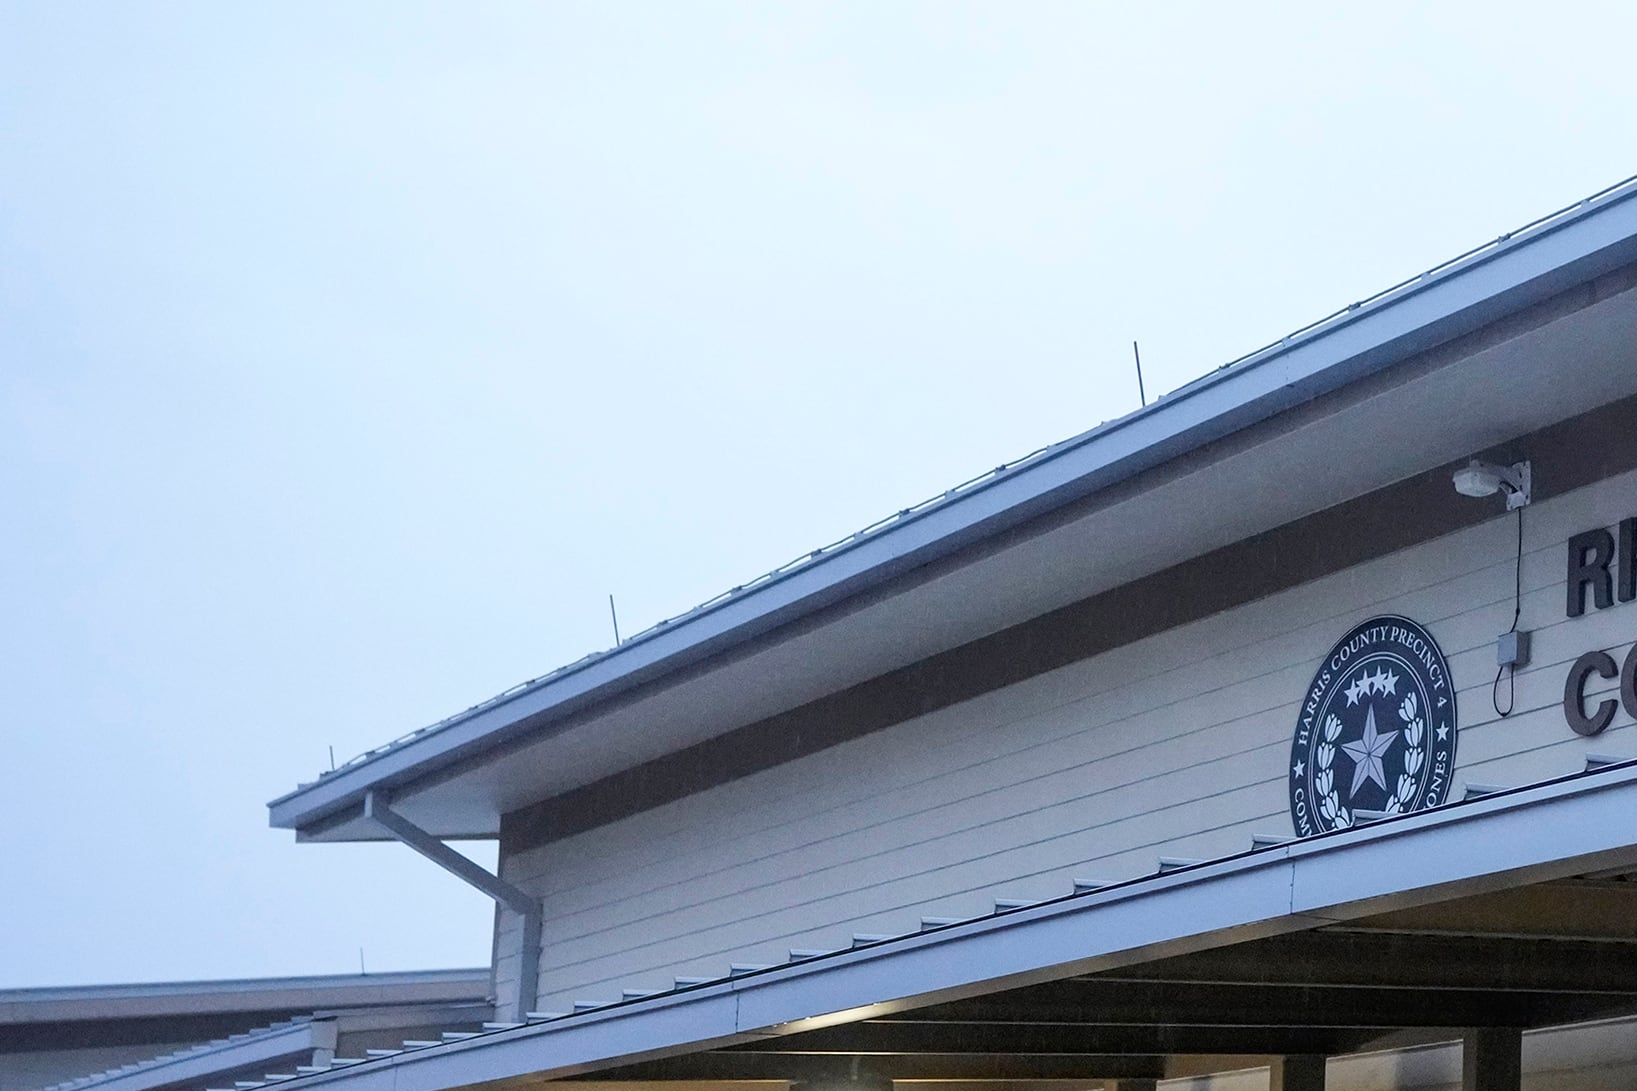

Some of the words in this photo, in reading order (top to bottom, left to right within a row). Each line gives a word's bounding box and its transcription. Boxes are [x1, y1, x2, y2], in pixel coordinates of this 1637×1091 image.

[1299, 670, 1331, 746] HARRIS
[1331, 625, 1389, 671] COUNTY
[1389, 626, 1446, 691] PRECINCT
[1437, 696, 1448, 708] 4
